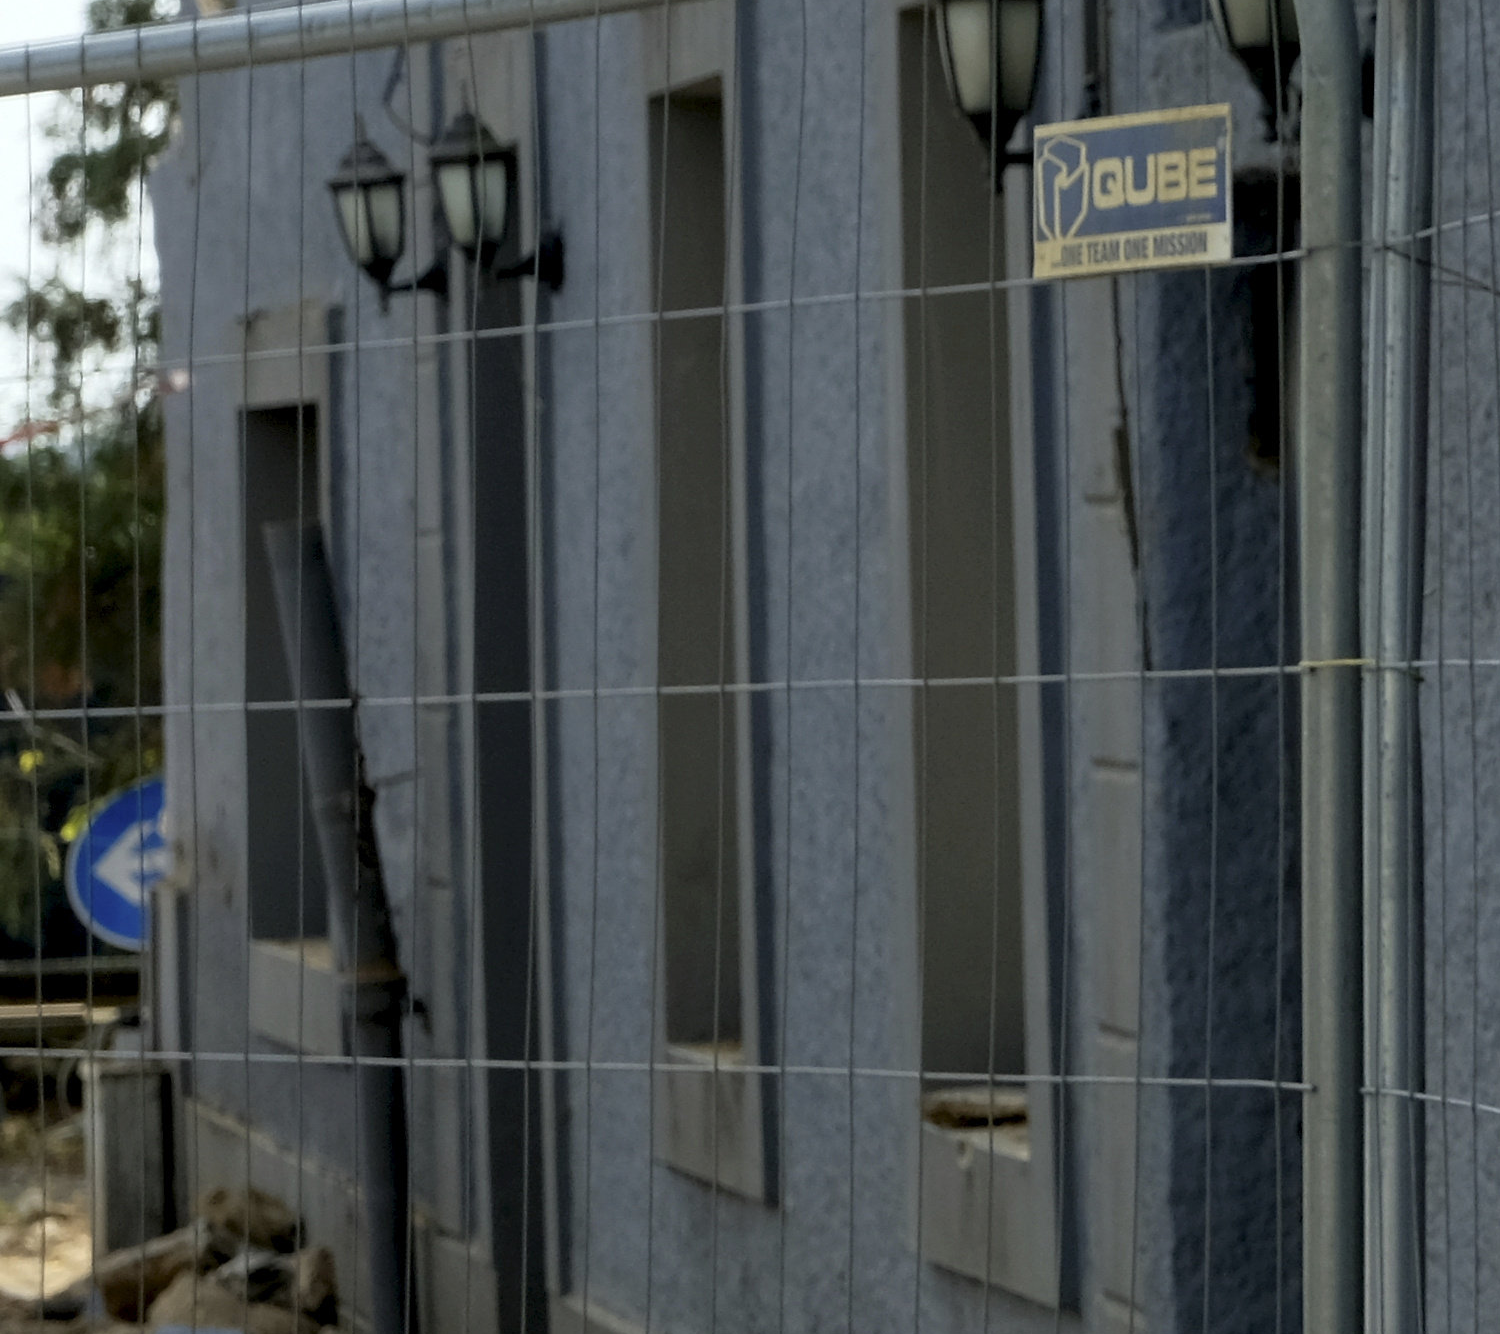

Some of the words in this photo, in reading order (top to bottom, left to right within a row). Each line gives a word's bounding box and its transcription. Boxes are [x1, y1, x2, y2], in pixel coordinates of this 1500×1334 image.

[1092, 147, 1218, 210] QUBE
[1087, 239, 1120, 263] TEAM
[1124, 235, 1149, 260] ONE
[1153, 230, 1207, 257] MISSION
